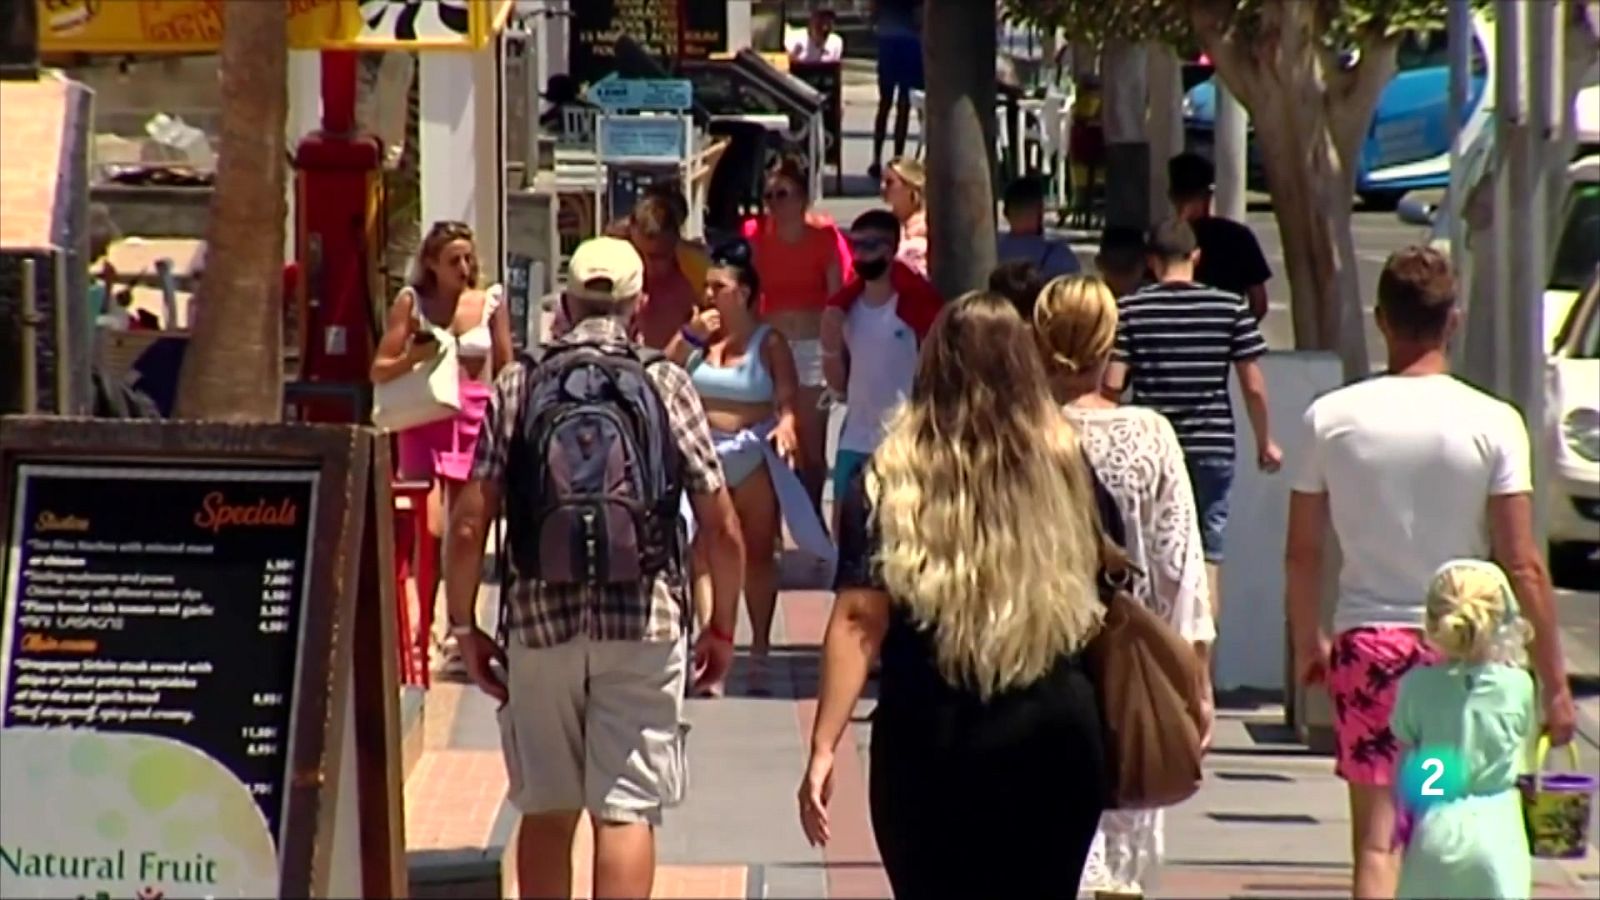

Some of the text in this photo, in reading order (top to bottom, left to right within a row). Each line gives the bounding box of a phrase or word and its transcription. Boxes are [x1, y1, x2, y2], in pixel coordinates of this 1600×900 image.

[194, 491, 297, 532] Specials
[57, 601, 90, 612] bread
[91, 602, 116, 613] with
[117, 604, 157, 614] tomato
[158, 603, 180, 615] and
[181, 604, 215, 619] garlic
[118, 661, 149, 672] steak
[150, 661, 187, 672] served
[188, 661, 213, 673] with
[60, 676, 96, 688] jacket
[138, 677, 198, 690] vegetables
[30, 690, 49, 701] the
[50, 689, 71, 703] day
[72, 690, 95, 702] and
[94, 690, 126, 704] garlic
[126, 690, 160, 703] bread
[100, 707, 128, 723] spicy
[129, 706, 152, 719] and
[0, 846, 218, 884] Natural Fruit
